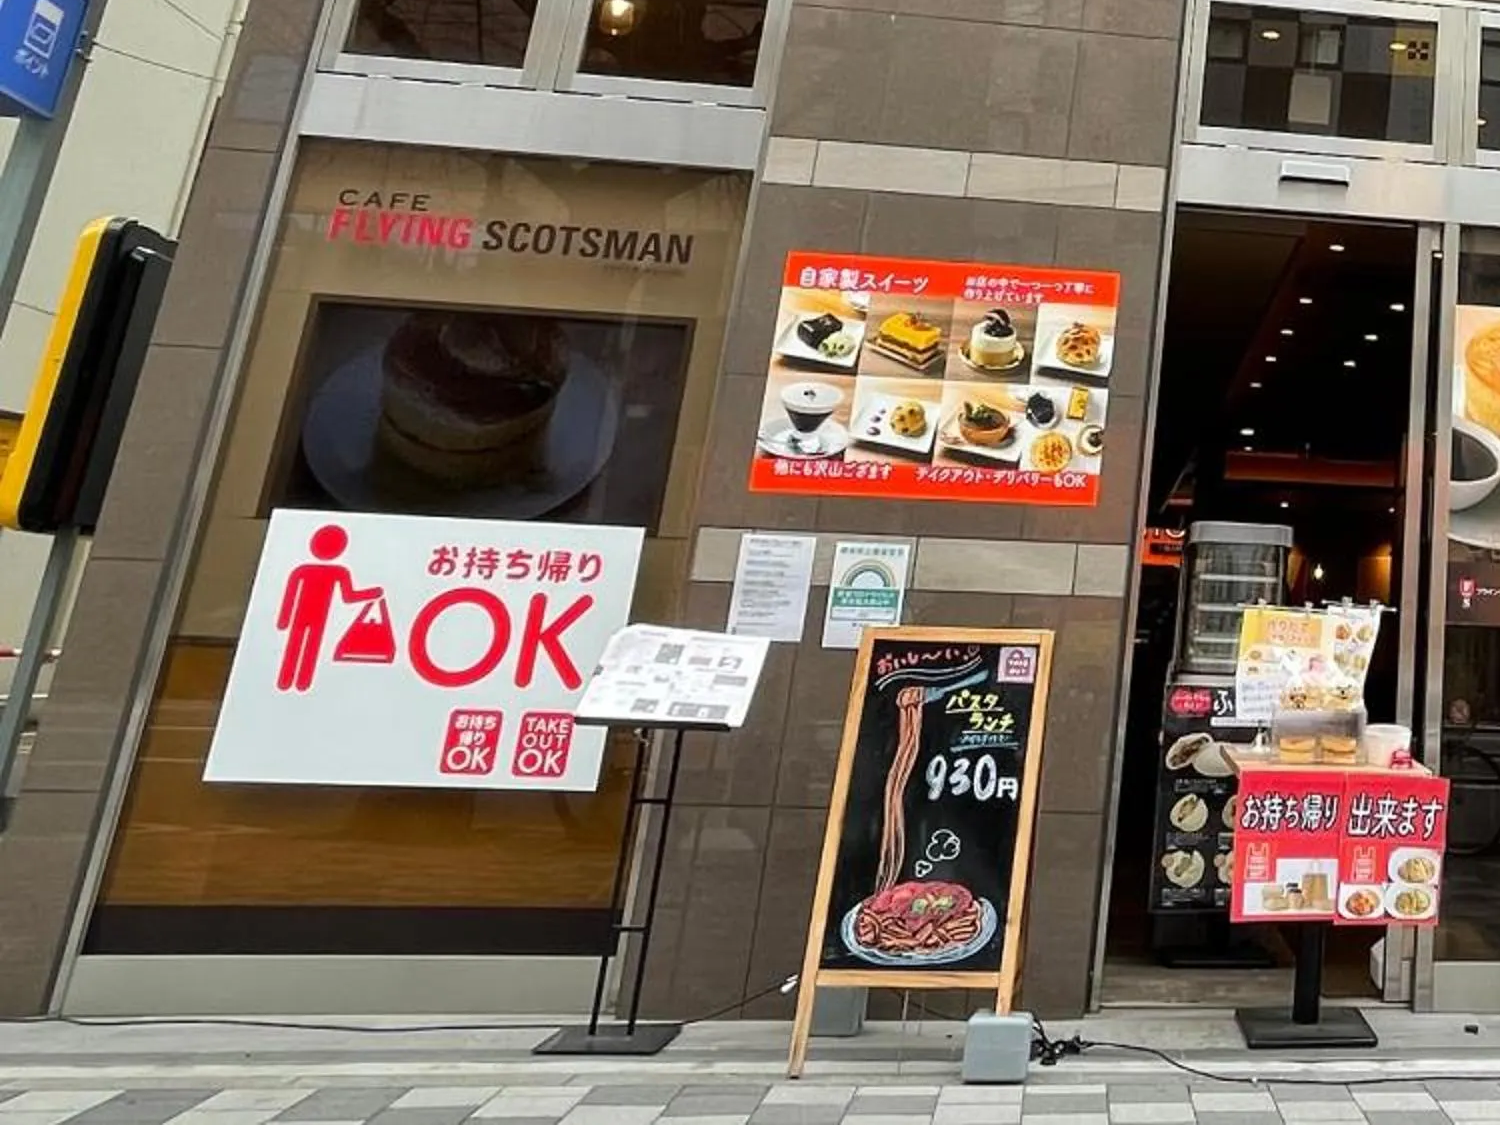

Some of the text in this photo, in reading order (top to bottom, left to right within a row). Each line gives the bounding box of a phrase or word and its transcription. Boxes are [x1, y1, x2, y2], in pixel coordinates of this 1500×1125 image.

[338, 189, 431, 211] CAFE
[327, 208, 695, 266] FLYING SCOTSMAN
[427, 545, 604, 584] お持ち帰り
[407, 586, 595, 693] OK
[945, 689, 1000, 709] パスタ
[454, 714, 498, 731] お持ち
[526, 716, 571, 734] TAKE
[968, 712, 1015, 732] ランチ
[459, 730, 486, 746] 帰り
[521, 733, 568, 749] OUT
[446, 746, 490, 772] OK
[517, 748, 563, 775] OK
[925, 754, 1019, 802] 930円
[1242, 793, 1444, 839] お持ち帰り 出来ます
